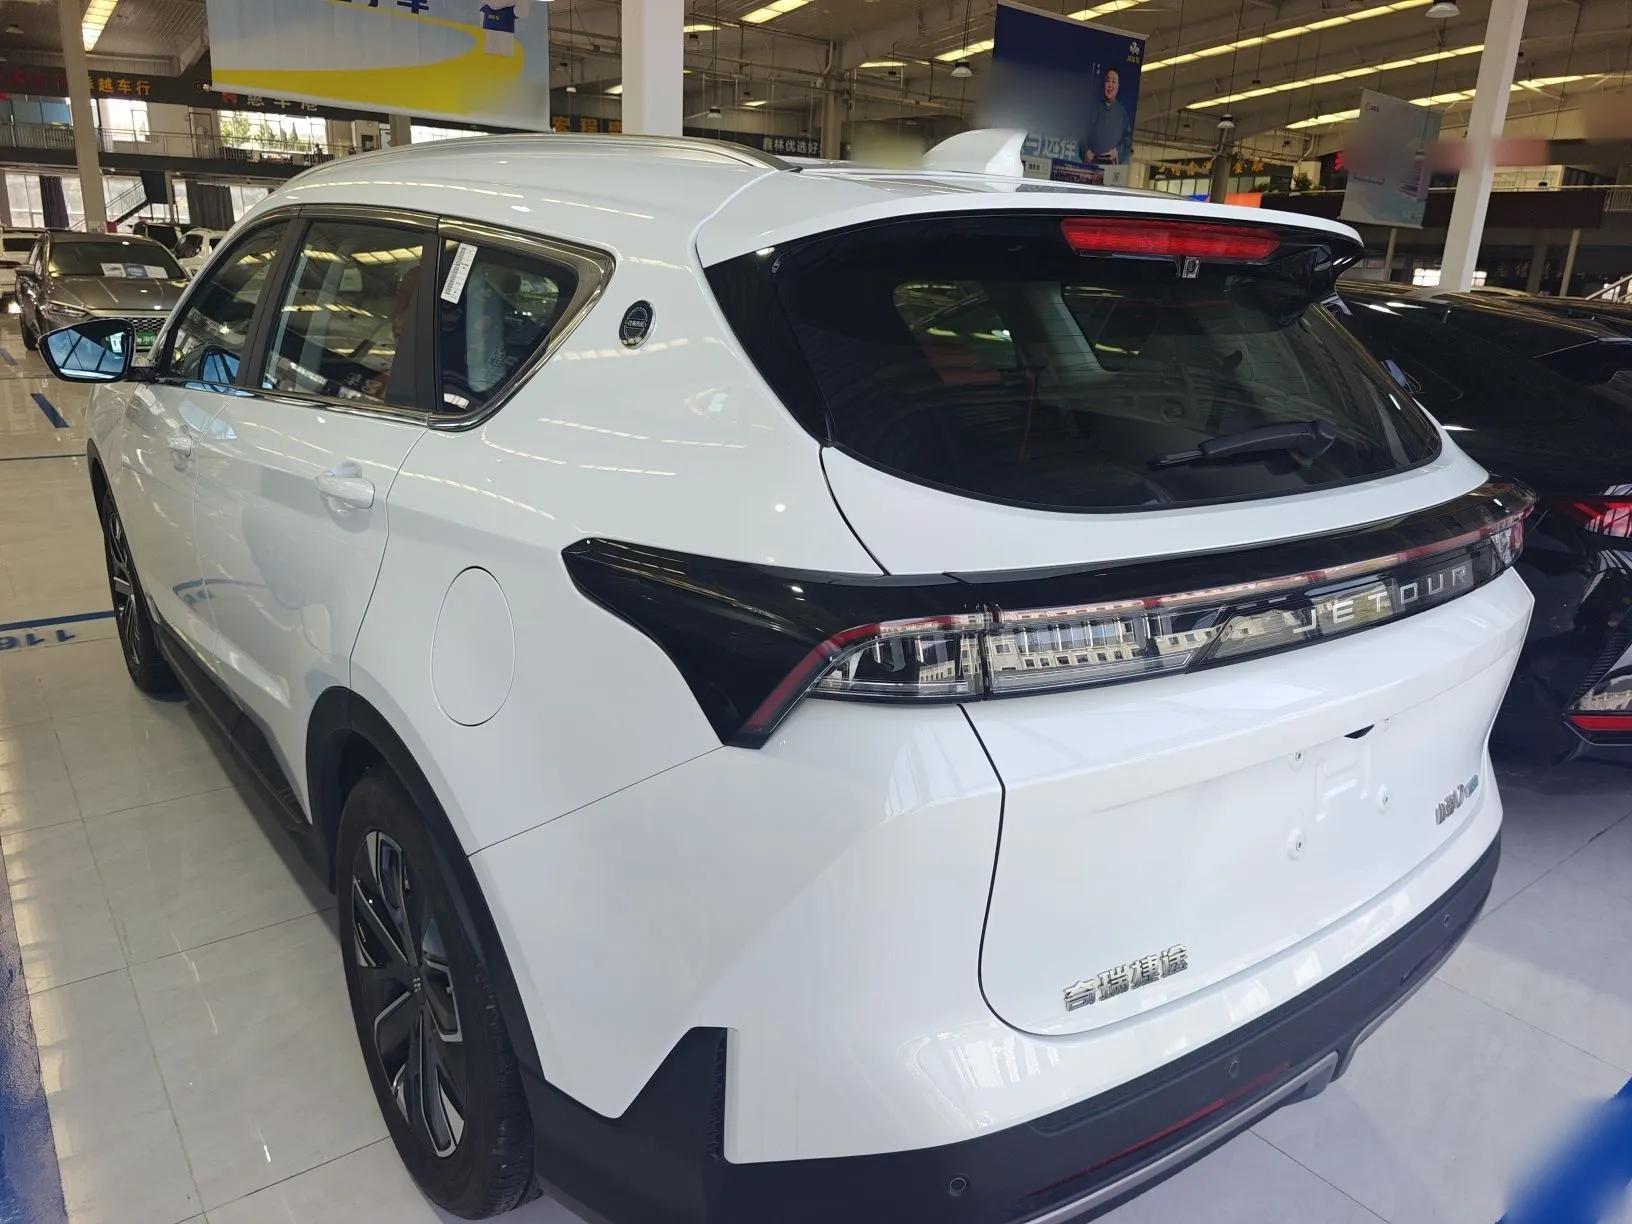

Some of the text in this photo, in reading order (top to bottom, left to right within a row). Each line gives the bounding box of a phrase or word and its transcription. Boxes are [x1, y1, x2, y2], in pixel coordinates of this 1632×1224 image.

[1293, 565, 1467, 634] JETOUR
[1063, 943, 1188, 1012] 奇瑞捷途
